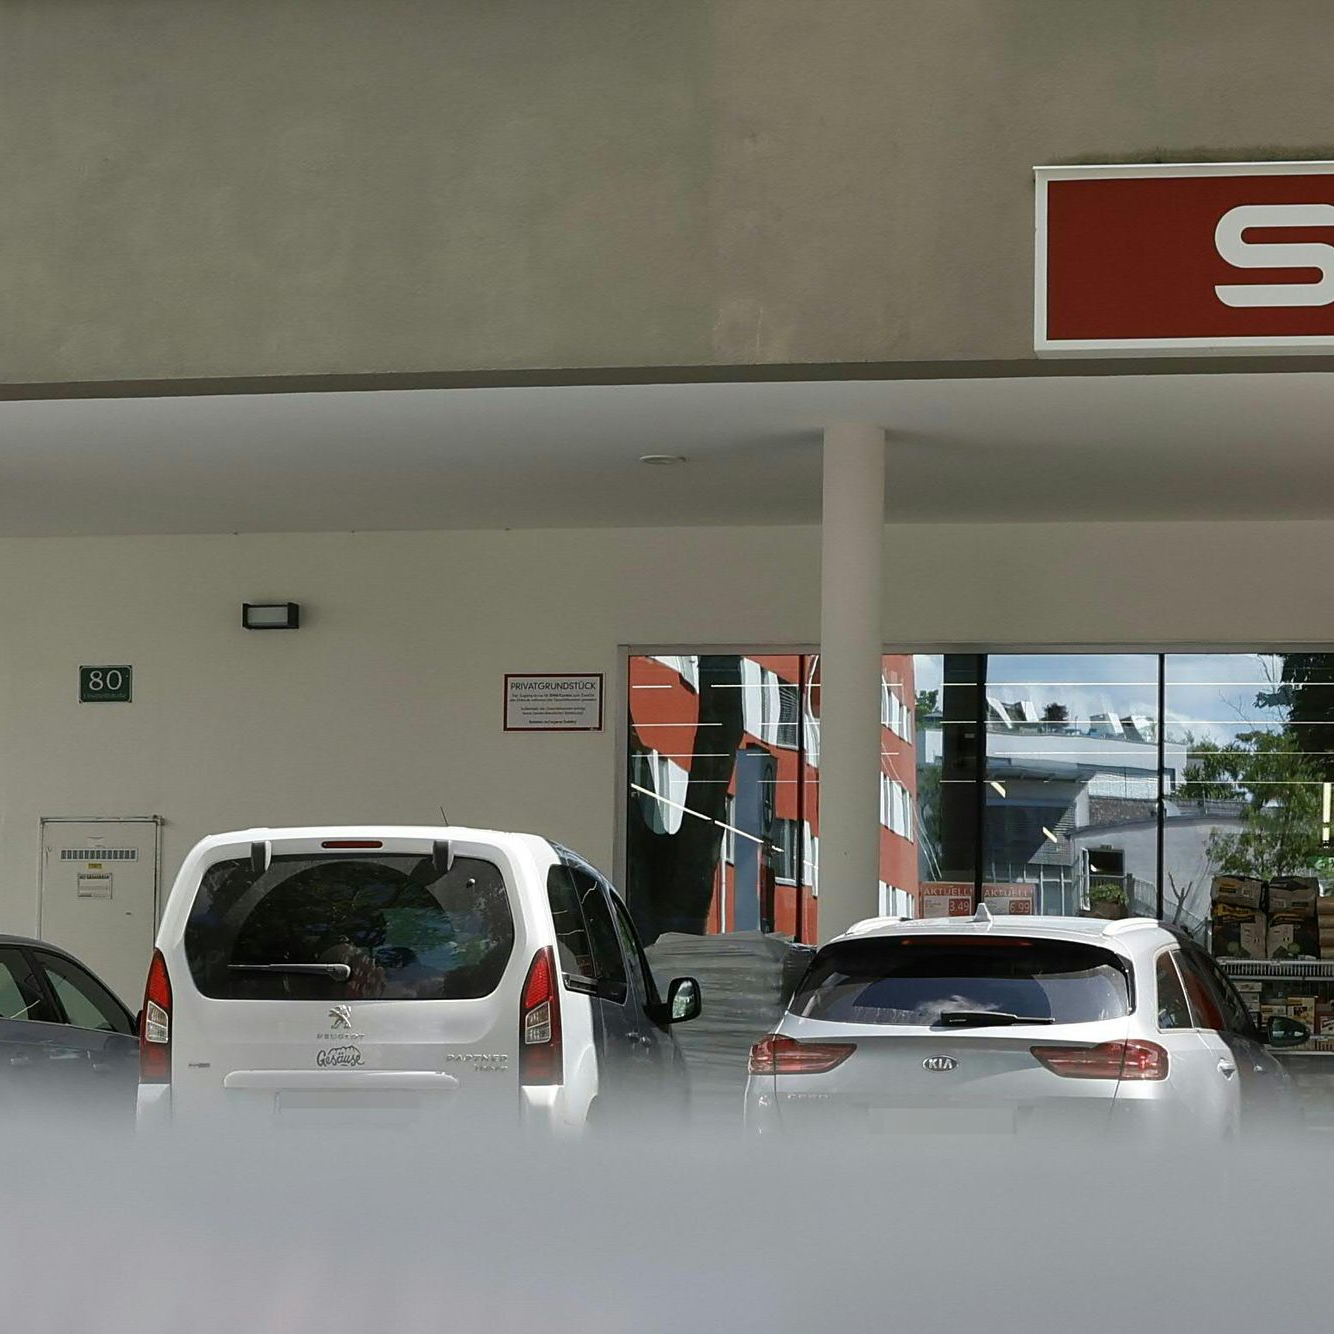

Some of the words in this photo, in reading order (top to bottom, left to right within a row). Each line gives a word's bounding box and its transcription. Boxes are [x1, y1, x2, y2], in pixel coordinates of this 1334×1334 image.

[89, 670, 122, 690] 80
[510, 681, 596, 690] PRIVATGRUNDSTÜCK
[949, 900, 970, 912] 3.49
[316, 1050, 365, 1067] Gesäuse
[928, 1058, 954, 1069] KIA
